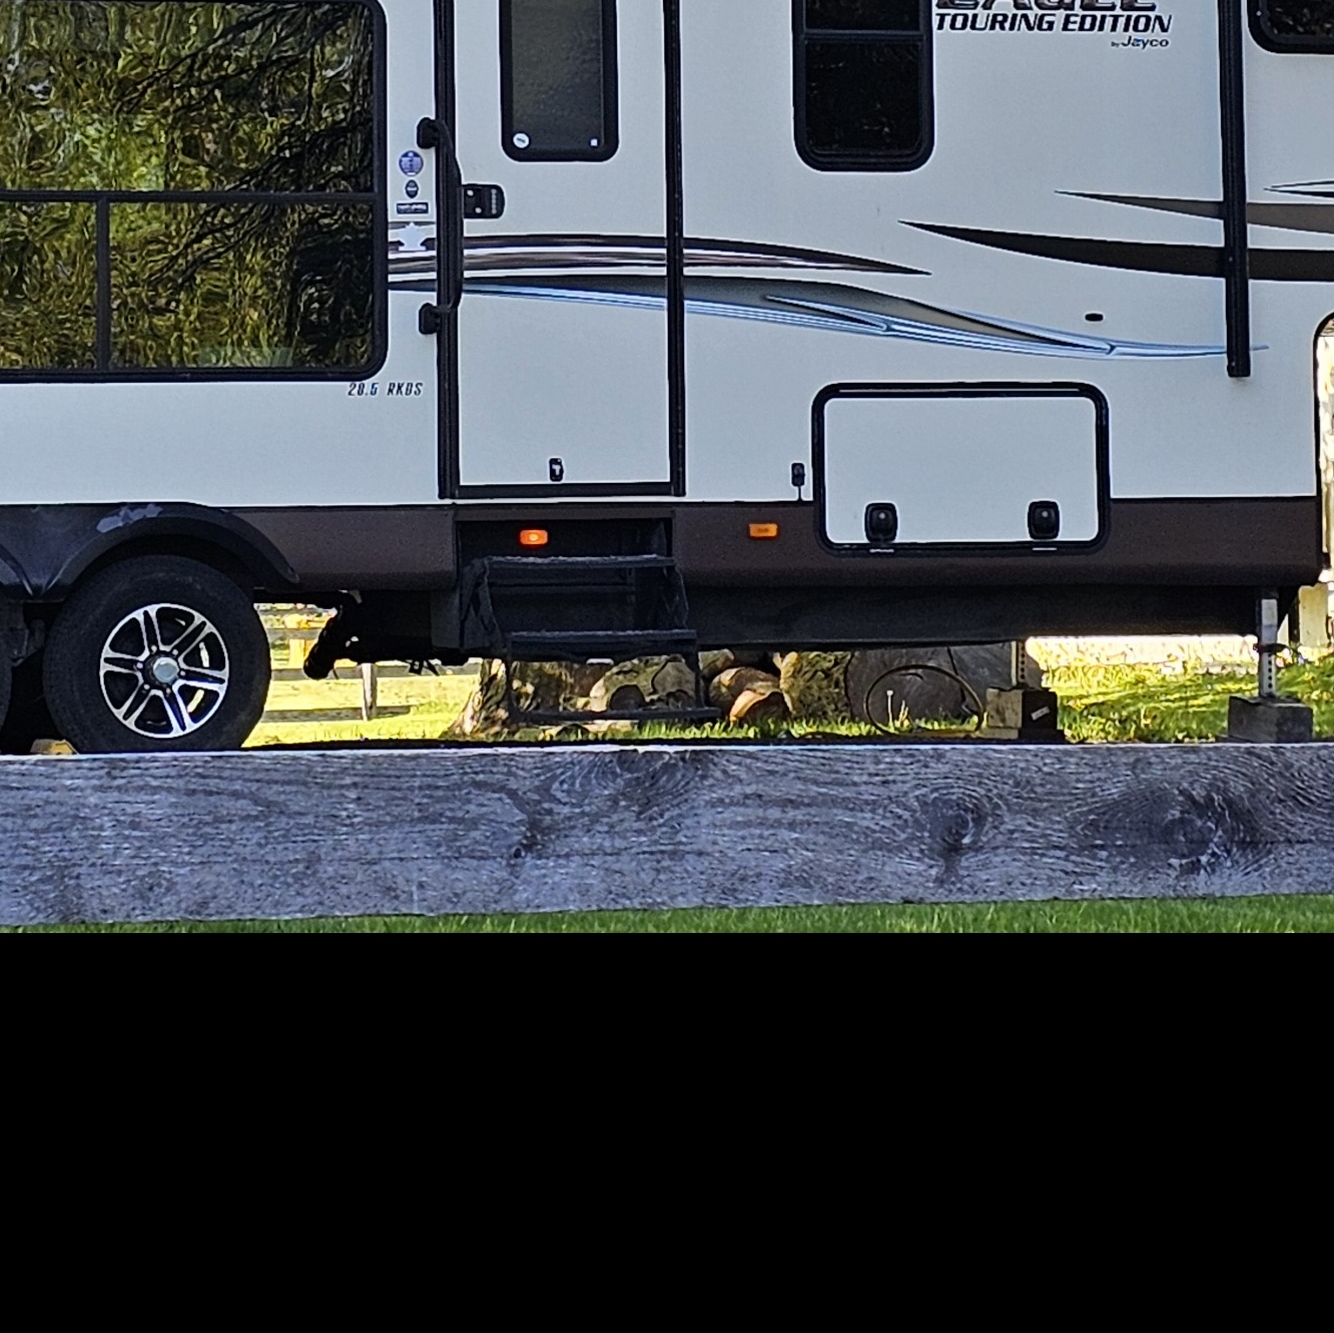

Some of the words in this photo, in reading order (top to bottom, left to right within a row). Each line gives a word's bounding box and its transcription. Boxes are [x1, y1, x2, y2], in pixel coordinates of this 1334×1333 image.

[935, 12, 1056, 33] TOURING
[1061, 13, 1173, 34] EDITION
[1120, 34, 1170, 51] Jayco
